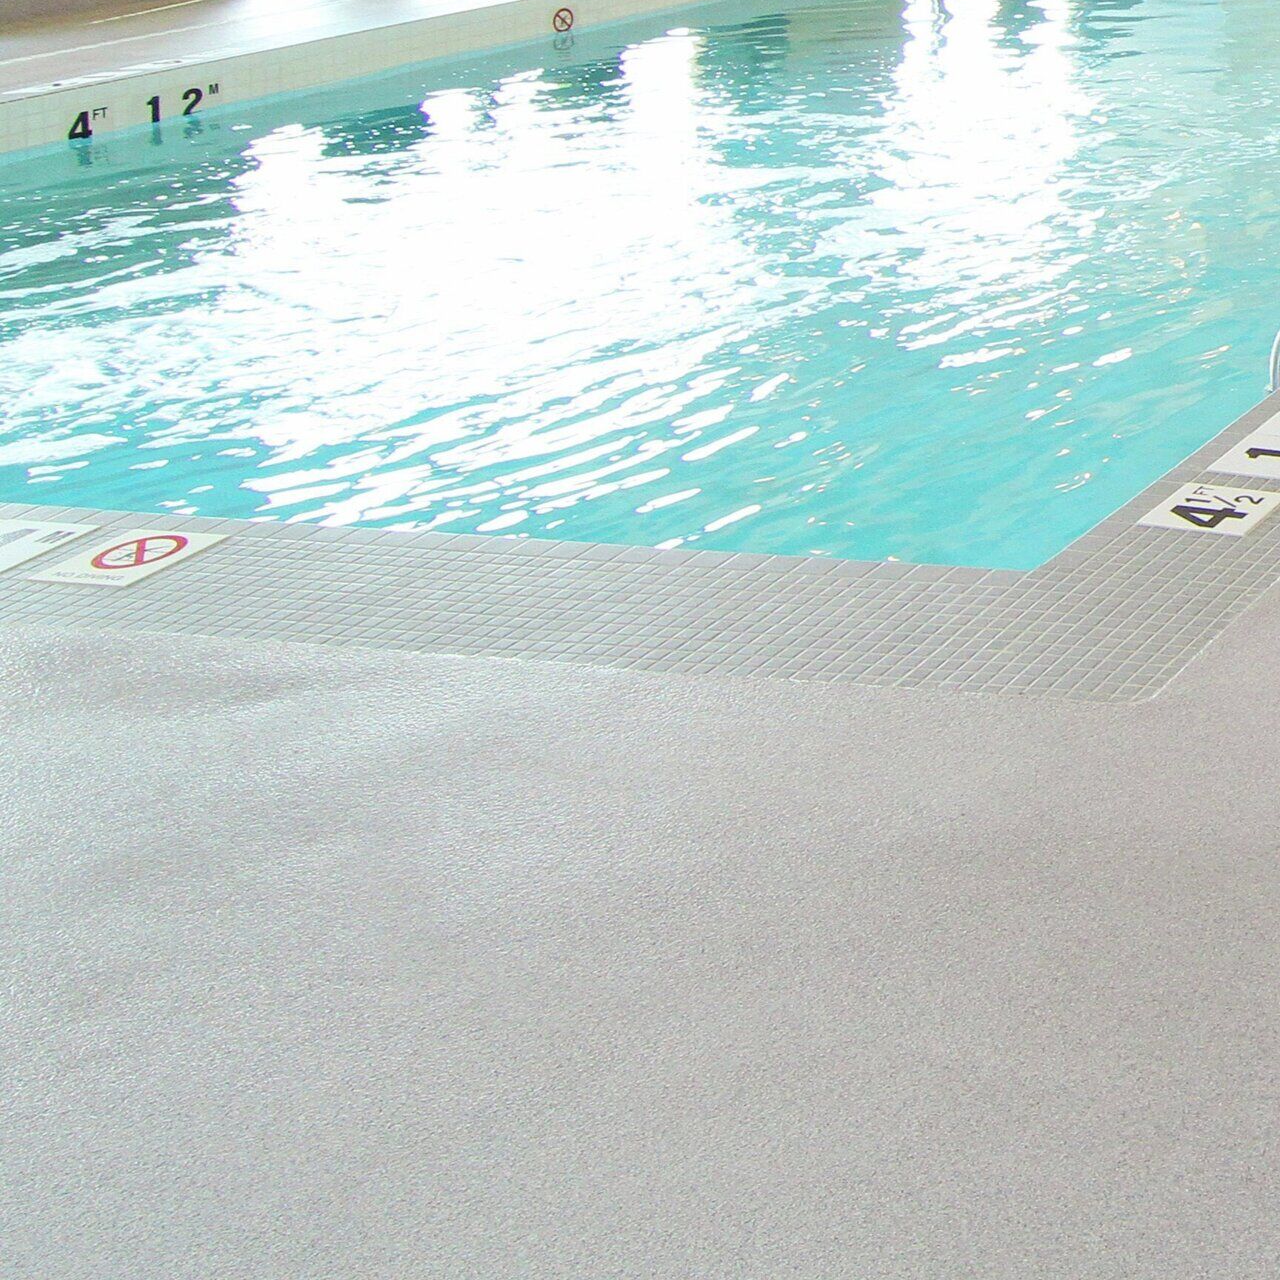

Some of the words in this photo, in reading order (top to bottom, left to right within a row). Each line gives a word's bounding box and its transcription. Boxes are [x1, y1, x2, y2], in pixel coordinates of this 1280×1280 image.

[68, 110, 93, 140] 4
[92, 107, 108, 120] FT
[208, 83, 220, 95] M
